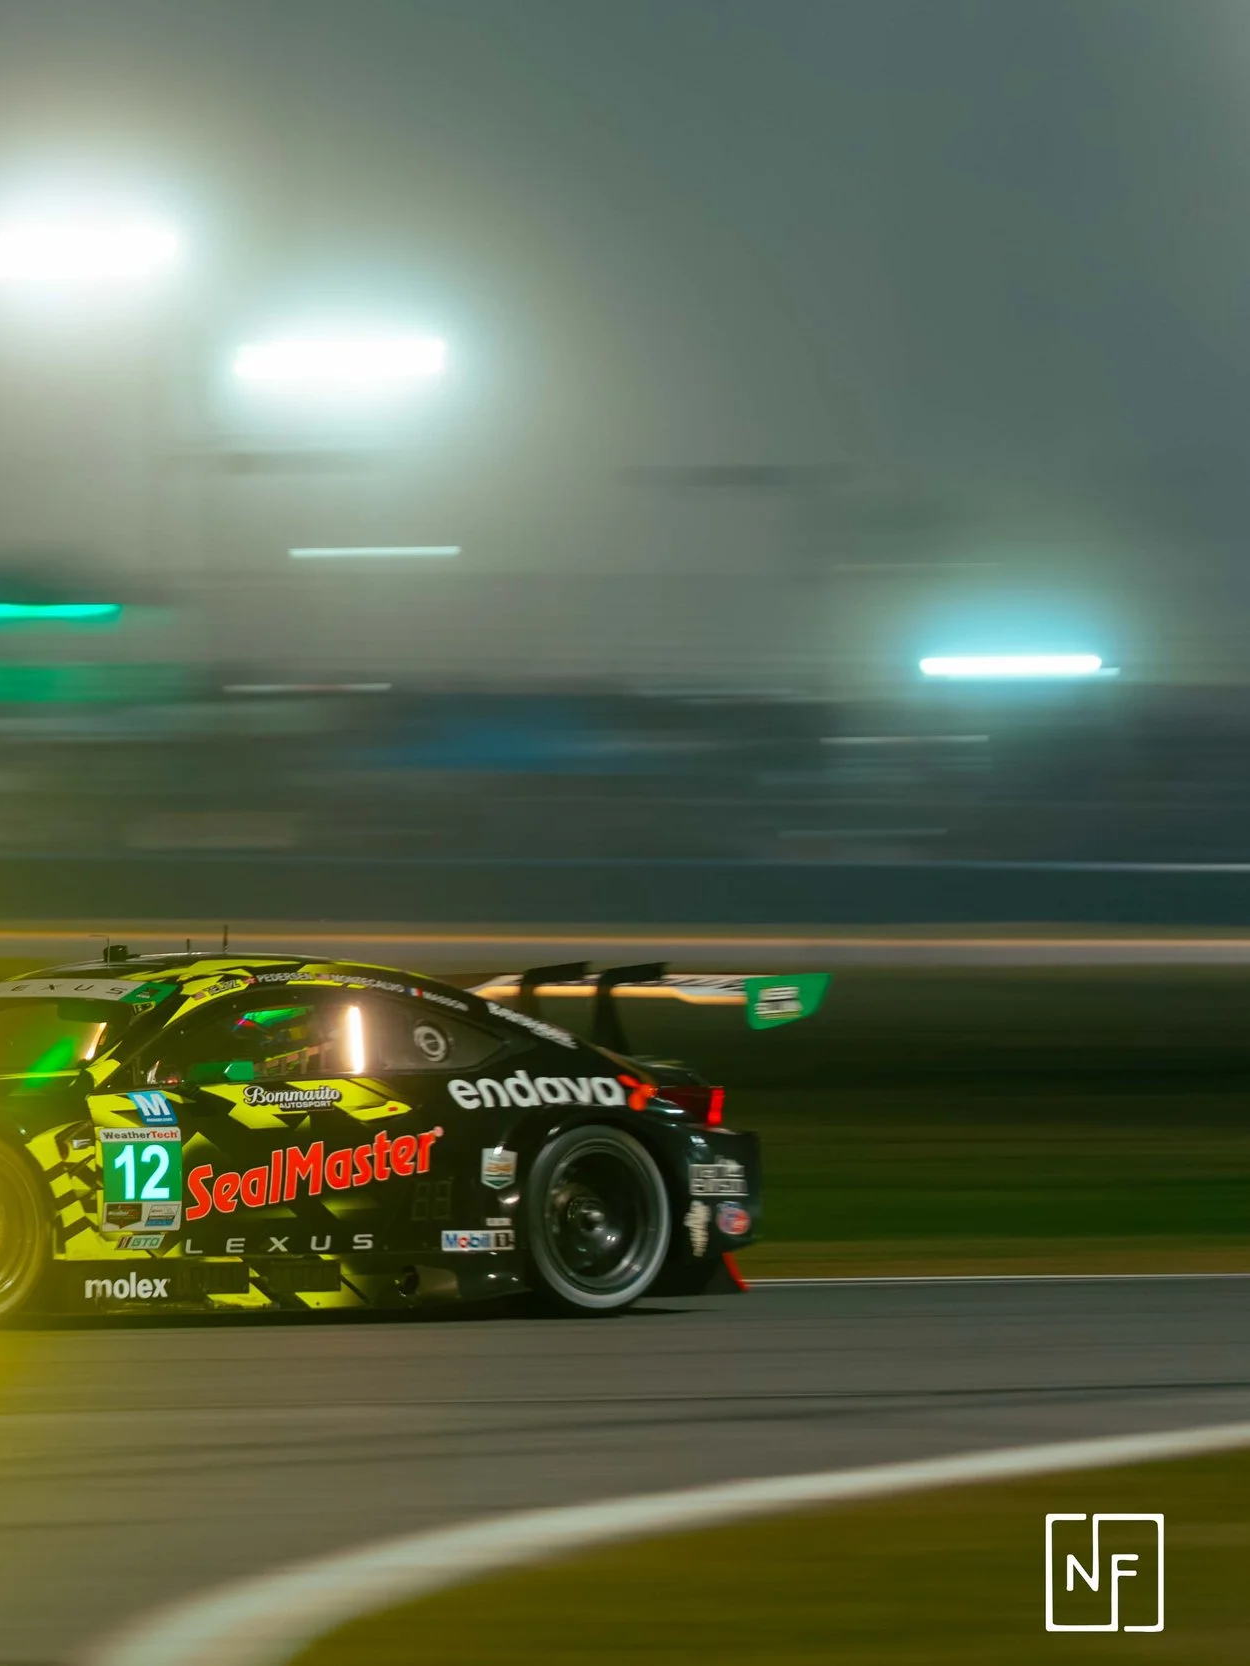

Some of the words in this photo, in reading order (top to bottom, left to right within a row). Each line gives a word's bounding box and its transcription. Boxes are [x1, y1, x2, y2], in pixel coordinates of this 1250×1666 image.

[244, 1085, 341, 1105] Bommarito
[447, 1070, 627, 1109] endava
[133, 1093, 171, 1116] M
[279, 1100, 332, 1109] AUTOSPORT
[102, 1130, 178, 1140] WeatherTech
[114, 1144, 170, 1200] 12
[185, 1130, 437, 1221] SealMaster
[185, 1234, 374, 1254] LEXUS
[85, 1272, 168, 1299] molex
